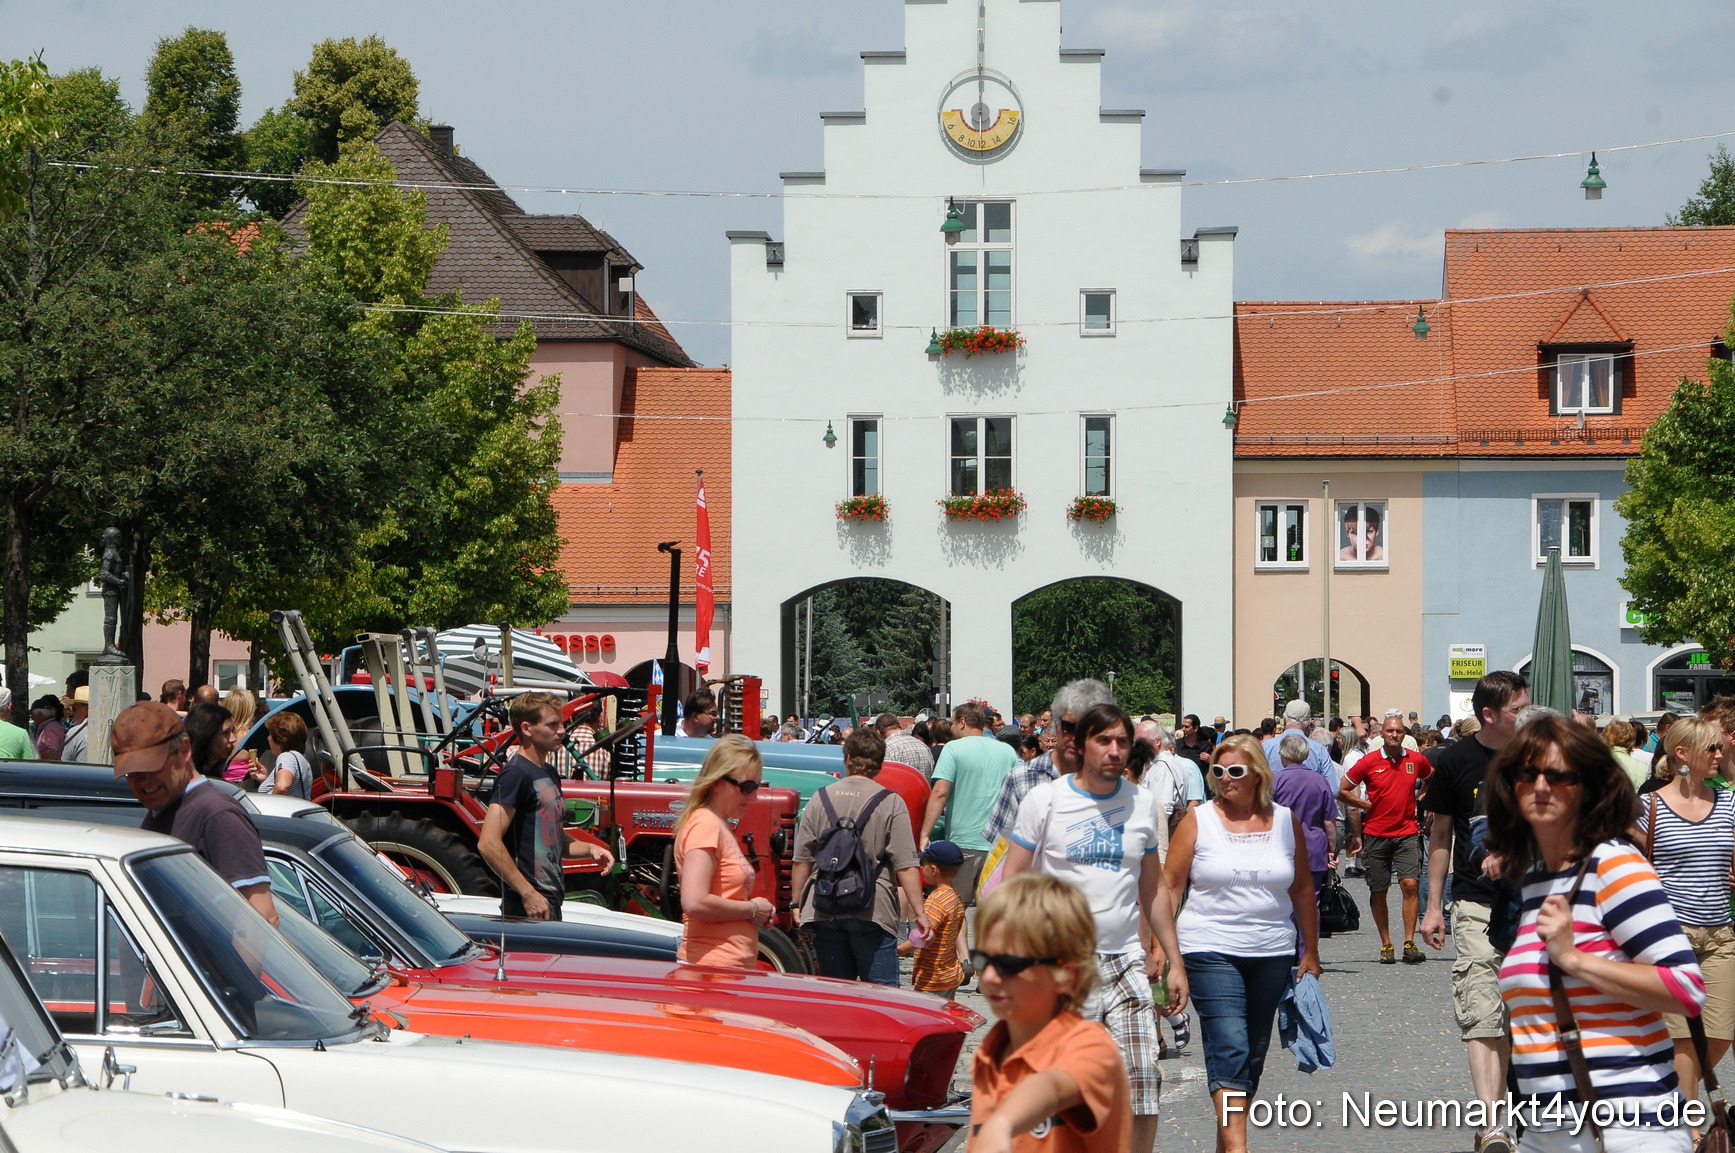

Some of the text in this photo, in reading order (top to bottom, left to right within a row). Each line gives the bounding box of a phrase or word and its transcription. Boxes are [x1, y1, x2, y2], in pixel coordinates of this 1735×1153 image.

[966, 138, 976, 148] 10
[977, 140, 987, 149] 12
[991, 135, 1001, 145] 14
